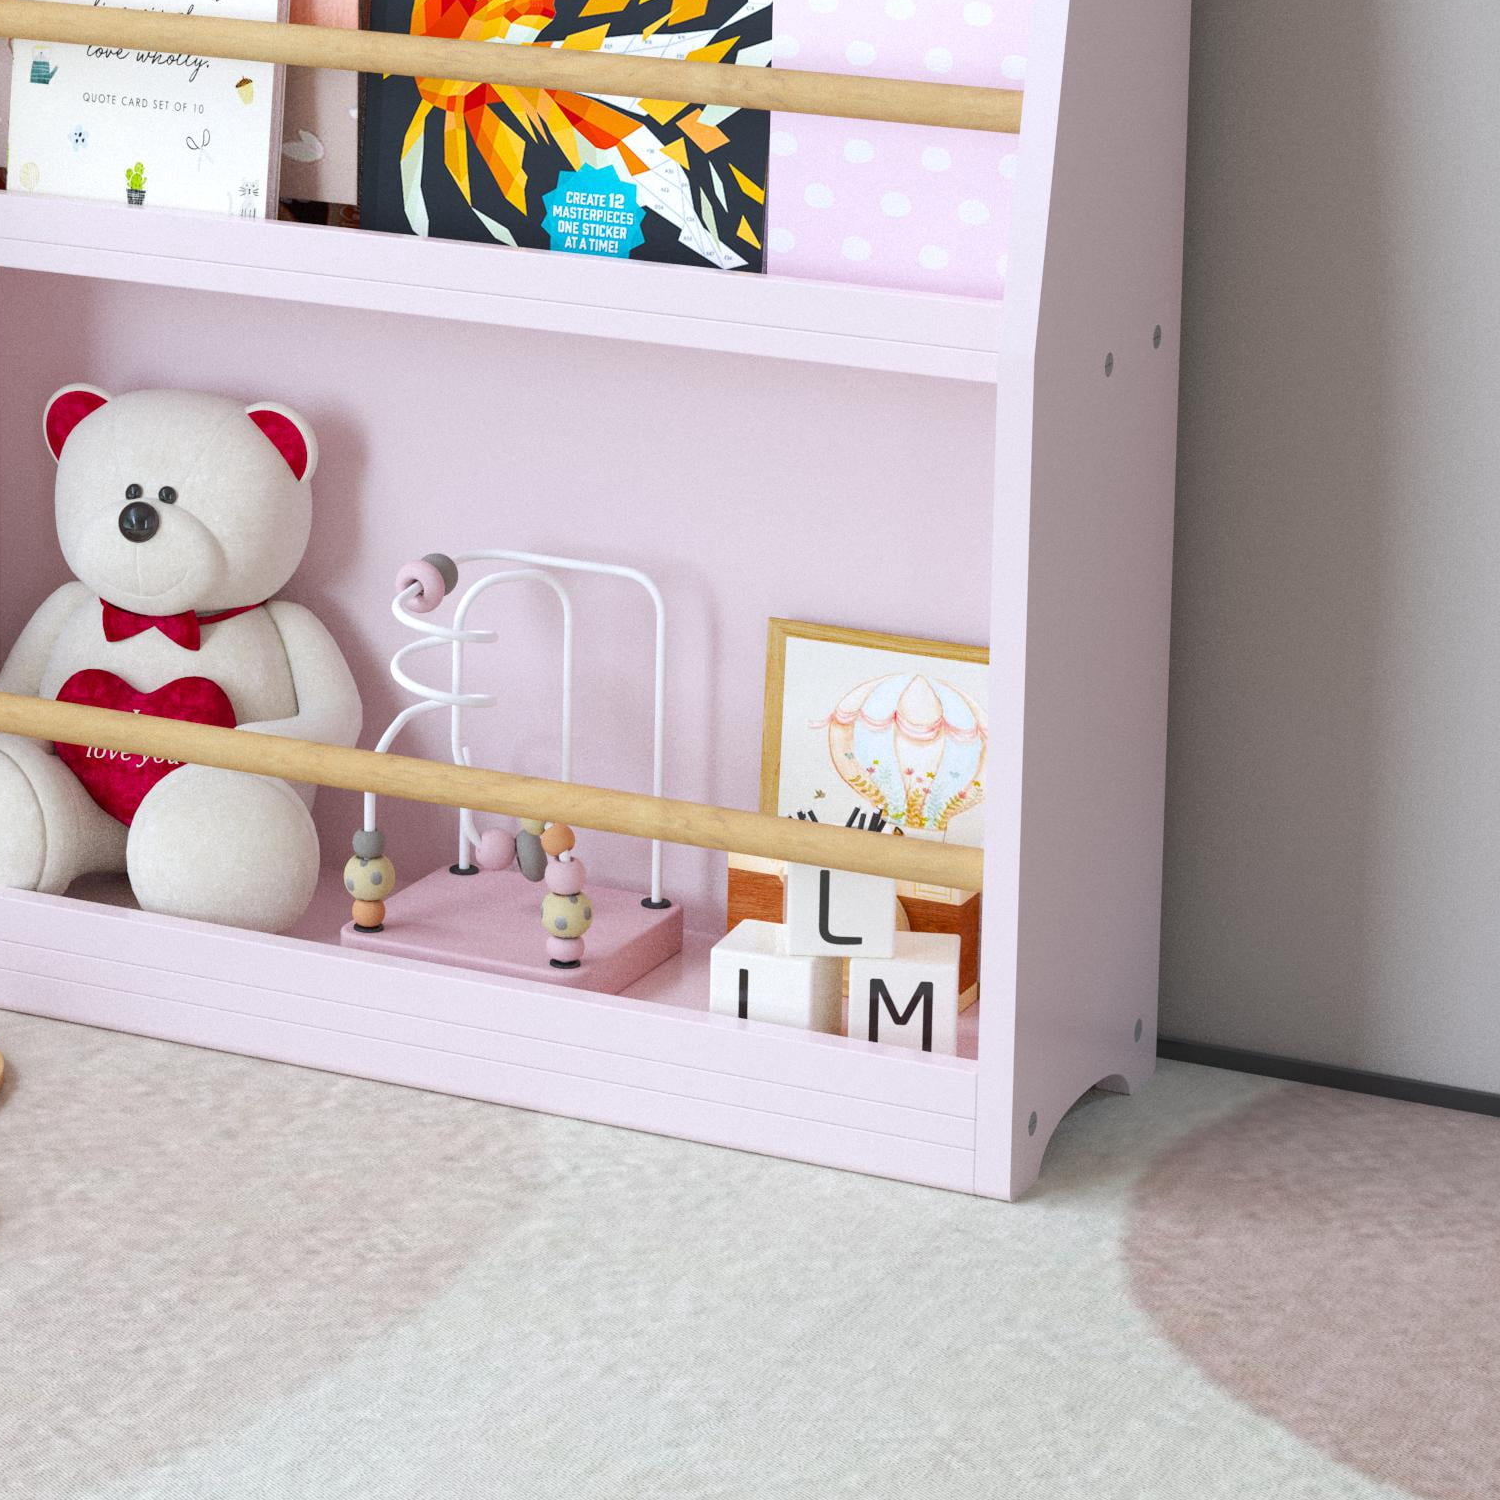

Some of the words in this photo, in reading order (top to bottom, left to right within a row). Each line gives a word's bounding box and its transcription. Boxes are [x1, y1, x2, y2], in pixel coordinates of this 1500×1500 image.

[82, 92, 117, 105] QUOTE
[121, 96, 148, 108] CARD
[153, 100, 169, 110] SET
[174, 101, 187, 112] OF
[193, 104, 204, 114] 10
[565, 191, 606, 207] CREATE
[608, 193, 625, 209] 12
[553, 205, 634, 225] MASTERPIECES
[558, 220, 580, 235] ONE
[582, 223, 627, 239] STICKER
[564, 236, 579, 249] AT
[579, 238, 587, 250] A
[589, 239, 619, 254] TIME!
[818, 869, 863, 946] L
[868, 978, 934, 1053] M
